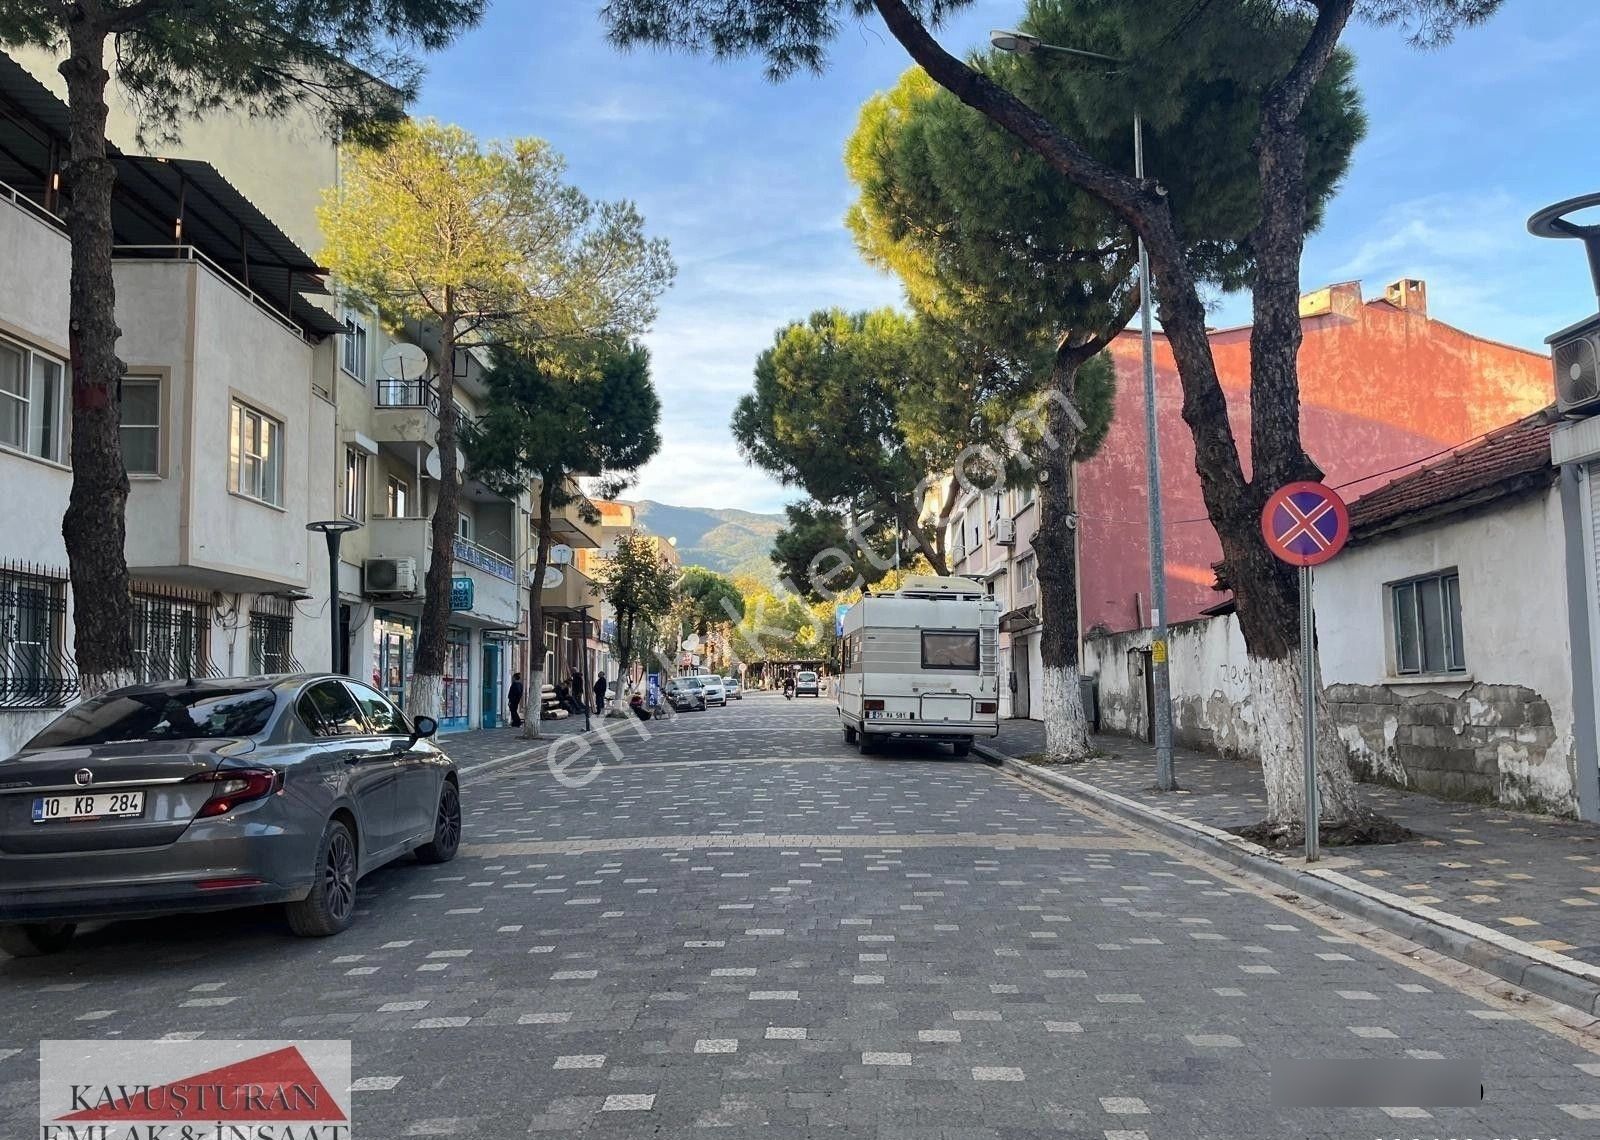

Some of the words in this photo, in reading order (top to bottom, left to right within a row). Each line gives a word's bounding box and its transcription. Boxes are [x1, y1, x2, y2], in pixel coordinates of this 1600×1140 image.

[452, 581, 469, 590] 101
[45, 799, 60, 816] 10
[74, 796, 95, 814] KB
[109, 794, 139, 812] 284
